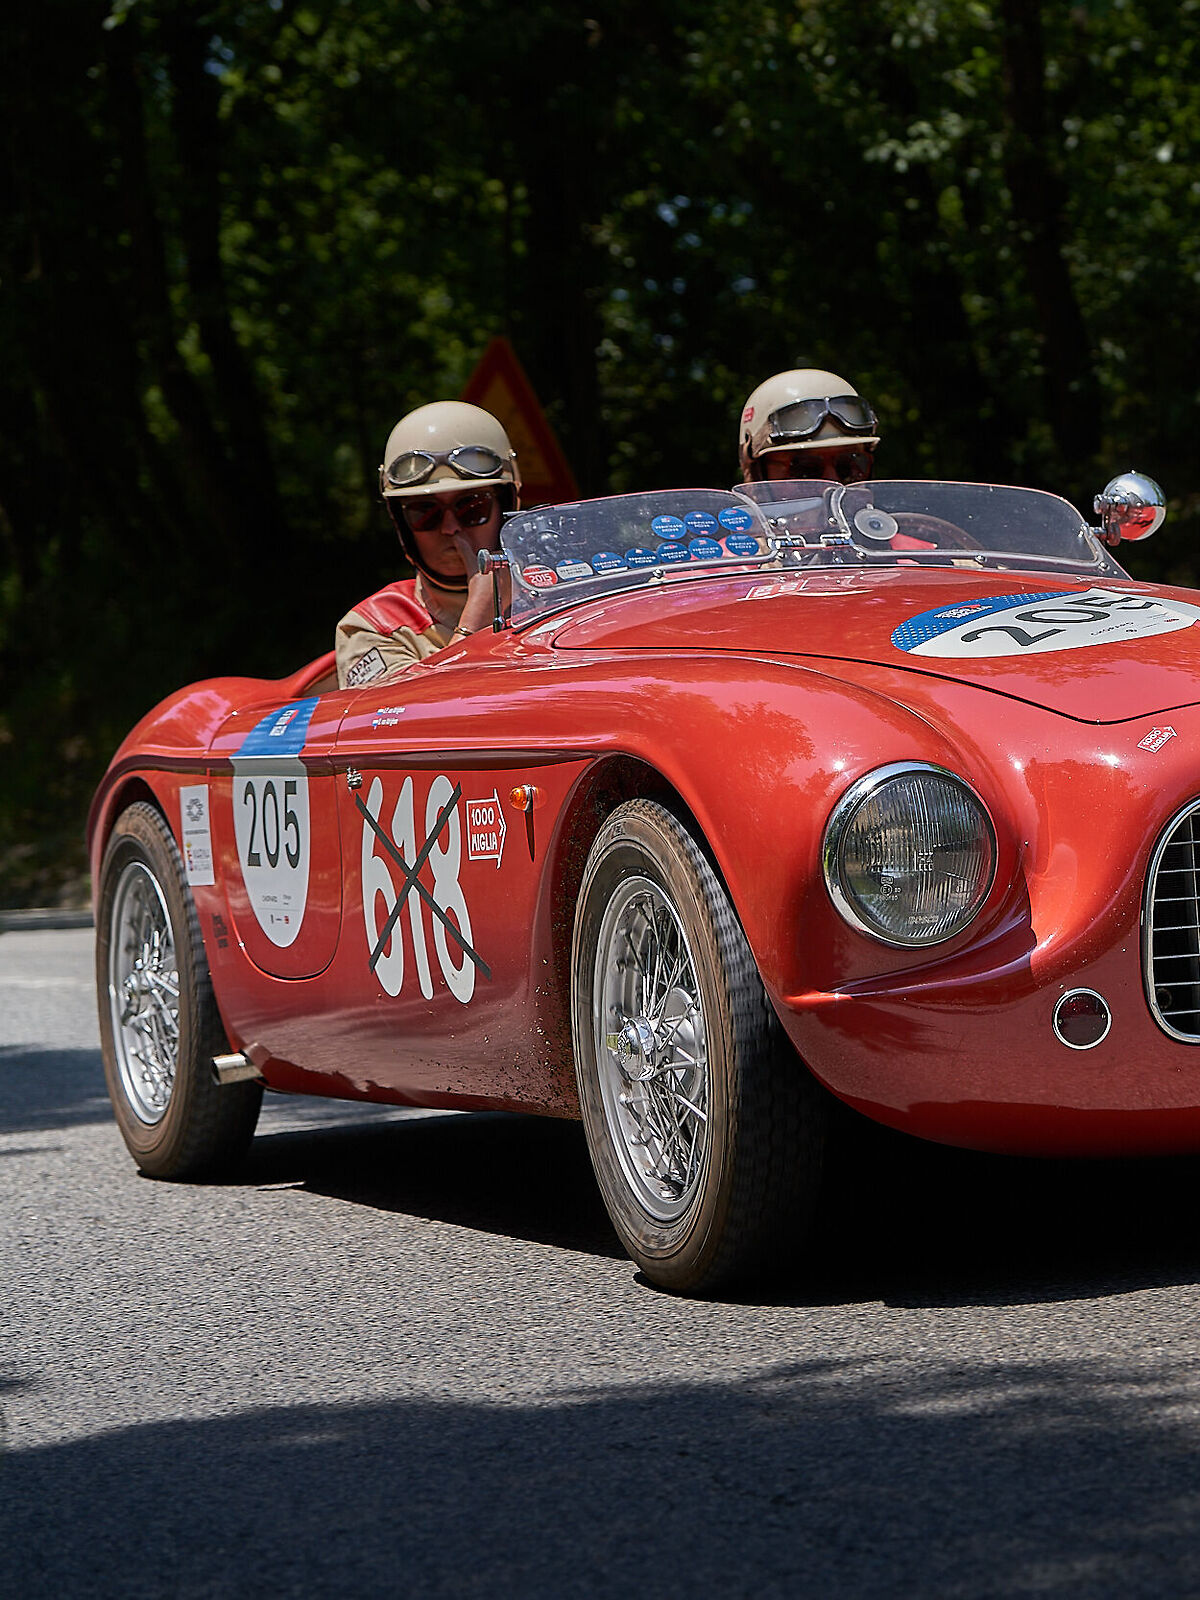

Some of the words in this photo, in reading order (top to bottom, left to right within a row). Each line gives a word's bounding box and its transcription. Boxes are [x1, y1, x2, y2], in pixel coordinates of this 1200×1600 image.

[528, 572, 553, 584] 2015
[1143, 730, 1162, 746] 1000
[244, 780, 300, 869] 205
[471, 806, 495, 827] 1000
[471, 831, 498, 852] MIGLIA
[361, 775, 476, 1004] 618
